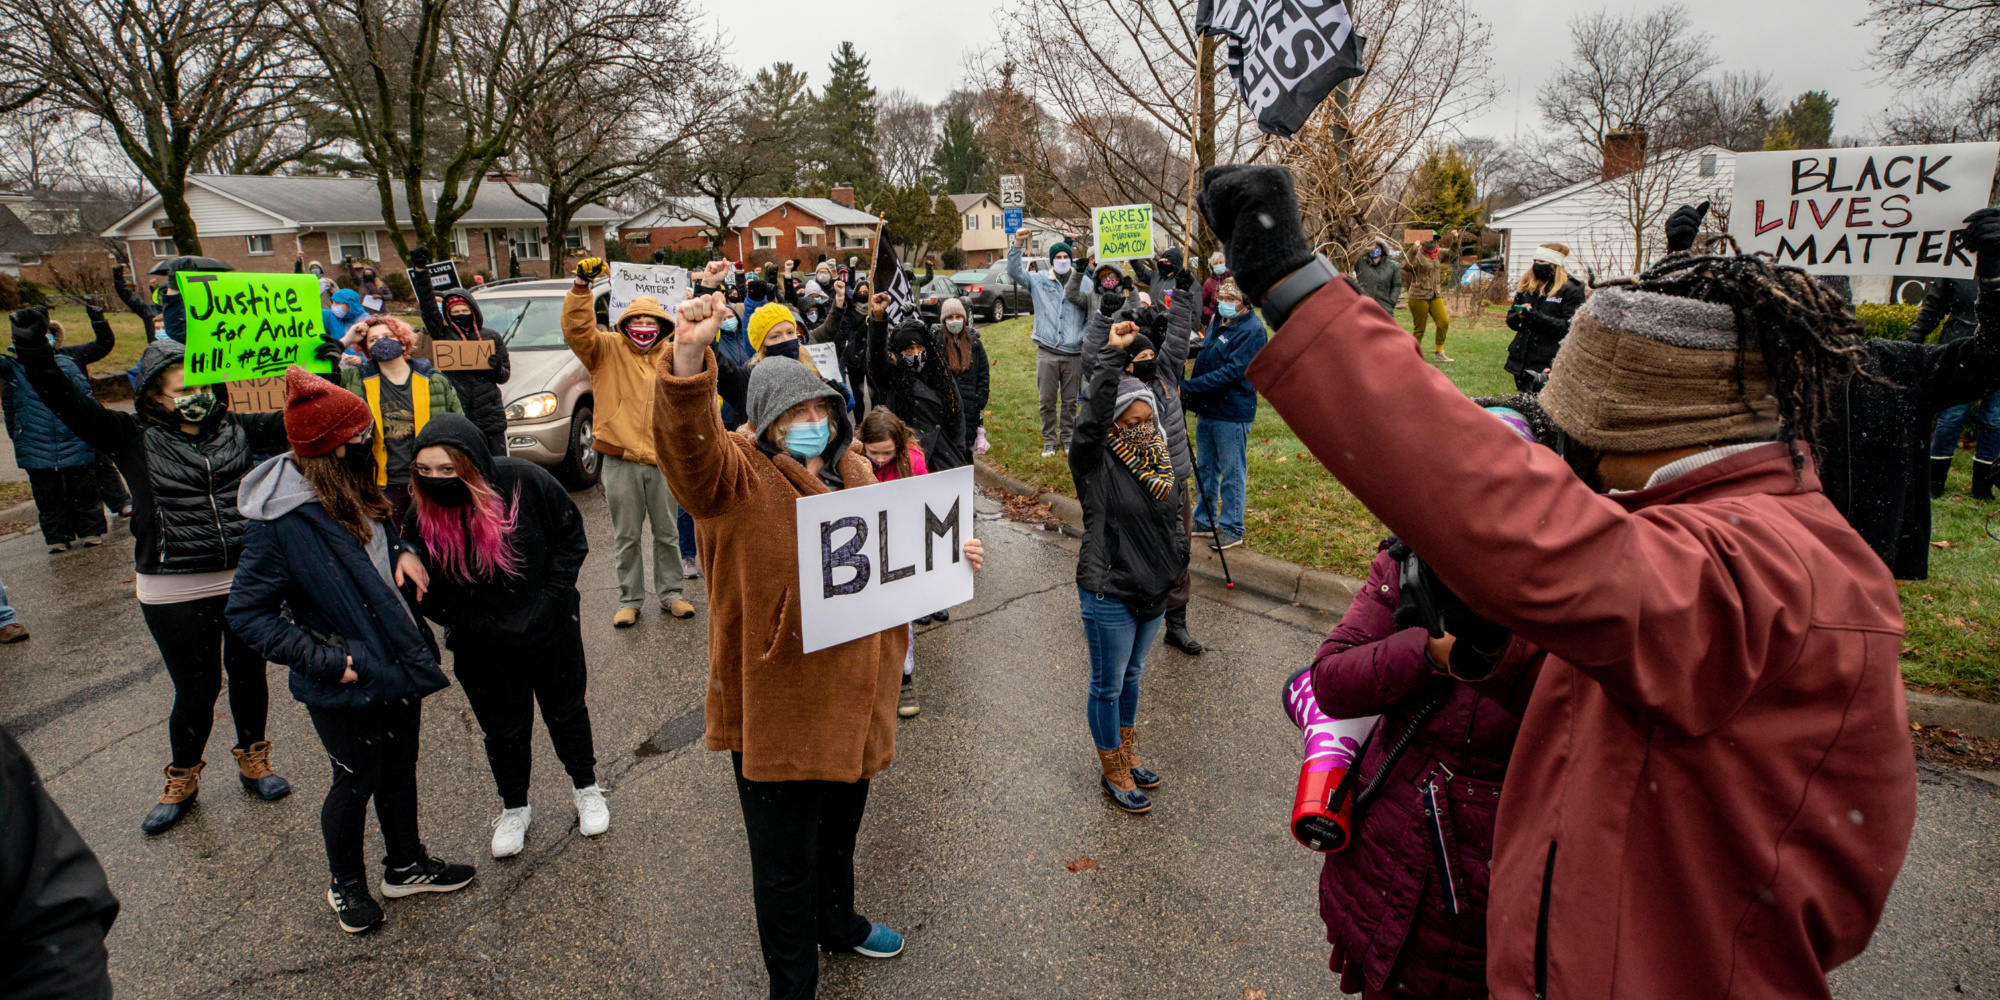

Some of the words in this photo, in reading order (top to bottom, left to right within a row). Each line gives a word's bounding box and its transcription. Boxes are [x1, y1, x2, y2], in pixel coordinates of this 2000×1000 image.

[1791, 155, 1952, 195] BLACK
[1003, 191, 1022, 203] 25
[1100, 208, 1150, 224] ARREST
[1755, 194, 1912, 237] LIVES
[1101, 224, 1122, 233] POLICE
[1103, 241, 1130, 254] ADAM
[1132, 240, 1146, 252] COY
[1775, 229, 1973, 267] MATTER
[432, 276, 448, 285] TTER
[433, 264, 452, 274] LIVES
[655, 273, 675, 284] LIVES
[186, 275, 302, 321] Justice
[211, 321, 247, 342] for
[255, 316, 318, 342] Andre
[191, 343, 232, 374] Hill!
[237, 344, 299, 369] #BLM
[436, 344, 492, 368] BLM
[820, 495, 960, 599] BLM
